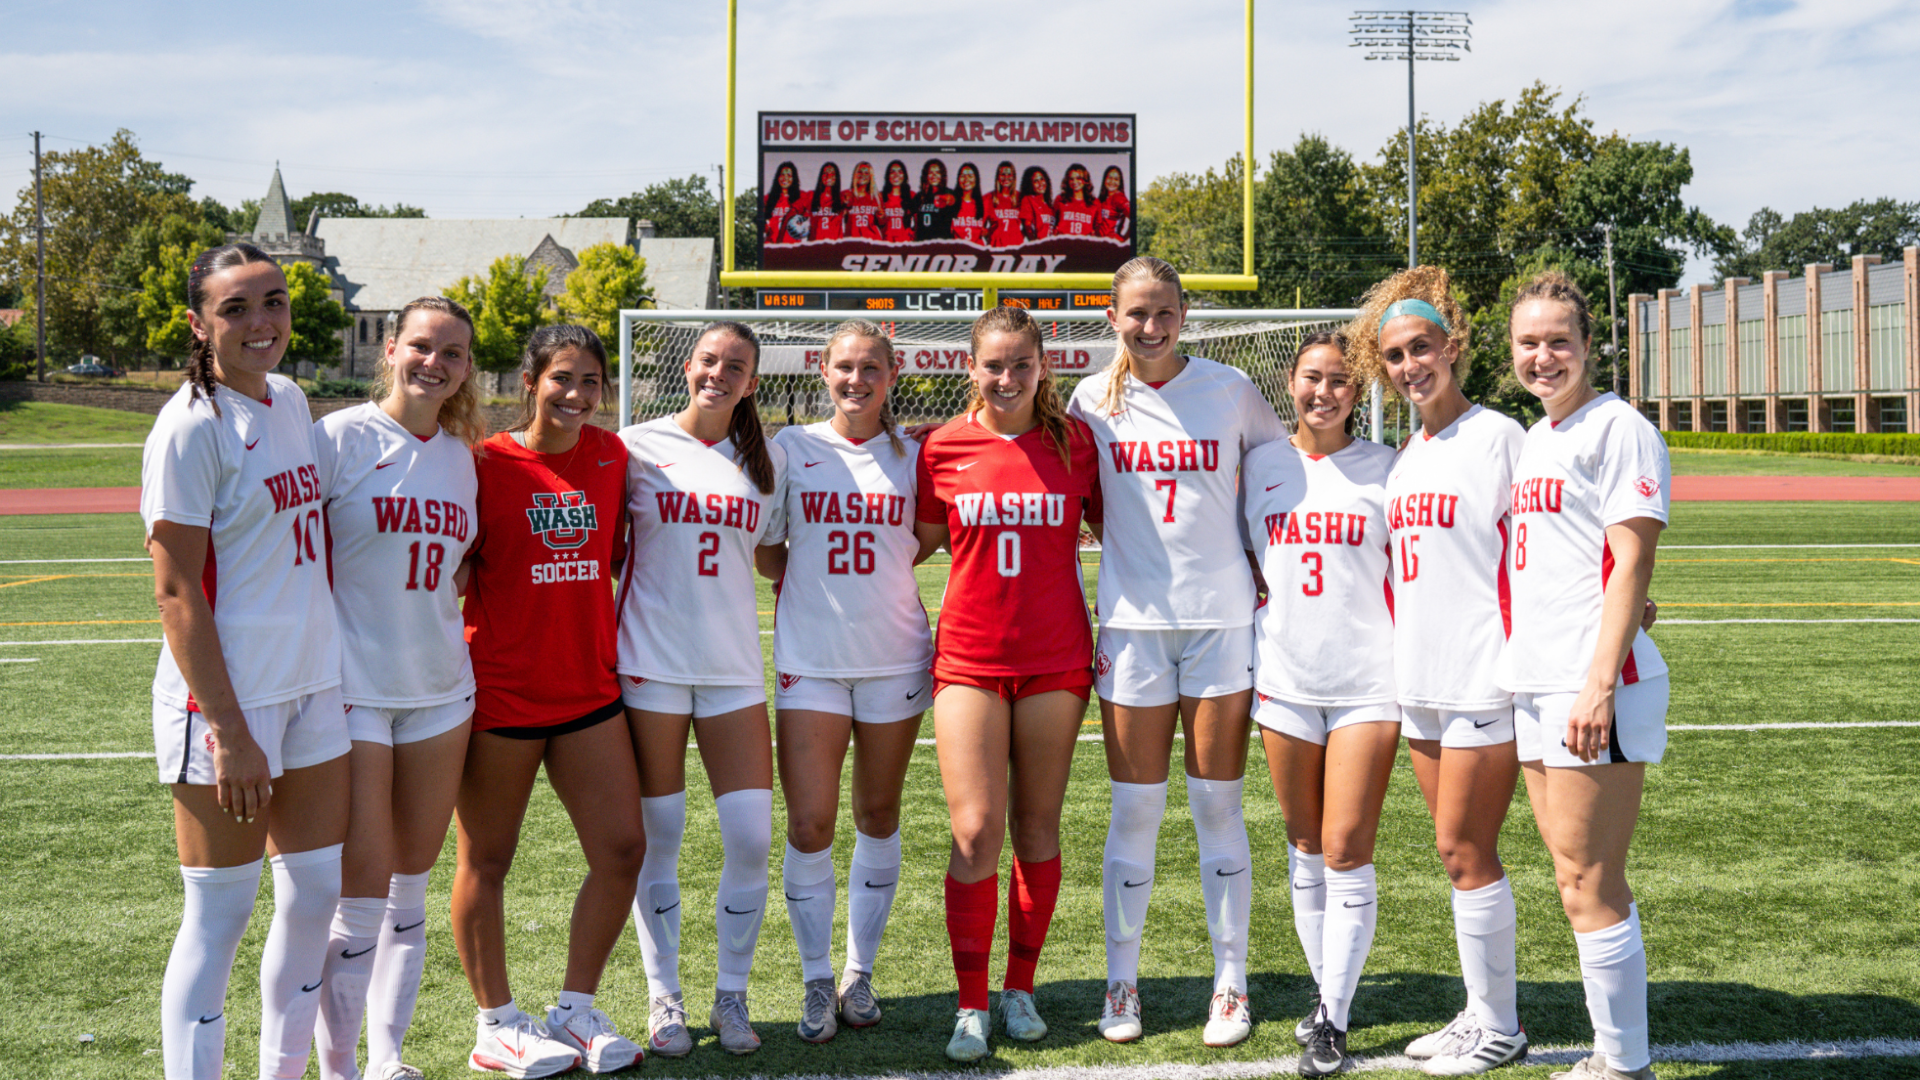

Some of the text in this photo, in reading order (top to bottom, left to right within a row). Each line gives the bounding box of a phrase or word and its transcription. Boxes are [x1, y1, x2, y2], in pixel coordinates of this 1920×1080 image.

[764, 119, 1130, 143] HOME OF SCHOLAR-CHAMPIONS
[821, 216, 829, 229] 2
[855, 214, 869, 227] 26
[1070, 222, 1083, 234] 18
[841, 254, 1067, 273] SENIOR DAY
[764, 294, 805, 306] WASHU
[866, 298, 895, 310] SHOTS
[1038, 298, 1062, 310] HALF
[1109, 439, 1219, 473] WASHU
[263, 463, 321, 514] WASH
[1155, 479, 1177, 523] 7
[371, 496, 469, 543] WASHU
[526, 504, 598, 535] WASH
[655, 491, 761, 534] WASHU
[800, 491, 906, 526] WASHU
[954, 492, 1066, 527] WASHU
[1264, 512, 1367, 547] WASHU
[1515, 522, 1527, 571] 8
[405, 540, 446, 592] 18
[698, 531, 720, 577] 2
[827, 530, 876, 575] 26
[997, 531, 1022, 577] 0
[1401, 534, 1420, 583] 15
[531, 560, 600, 585] SOCCER
[1301, 551, 1324, 597] 3
